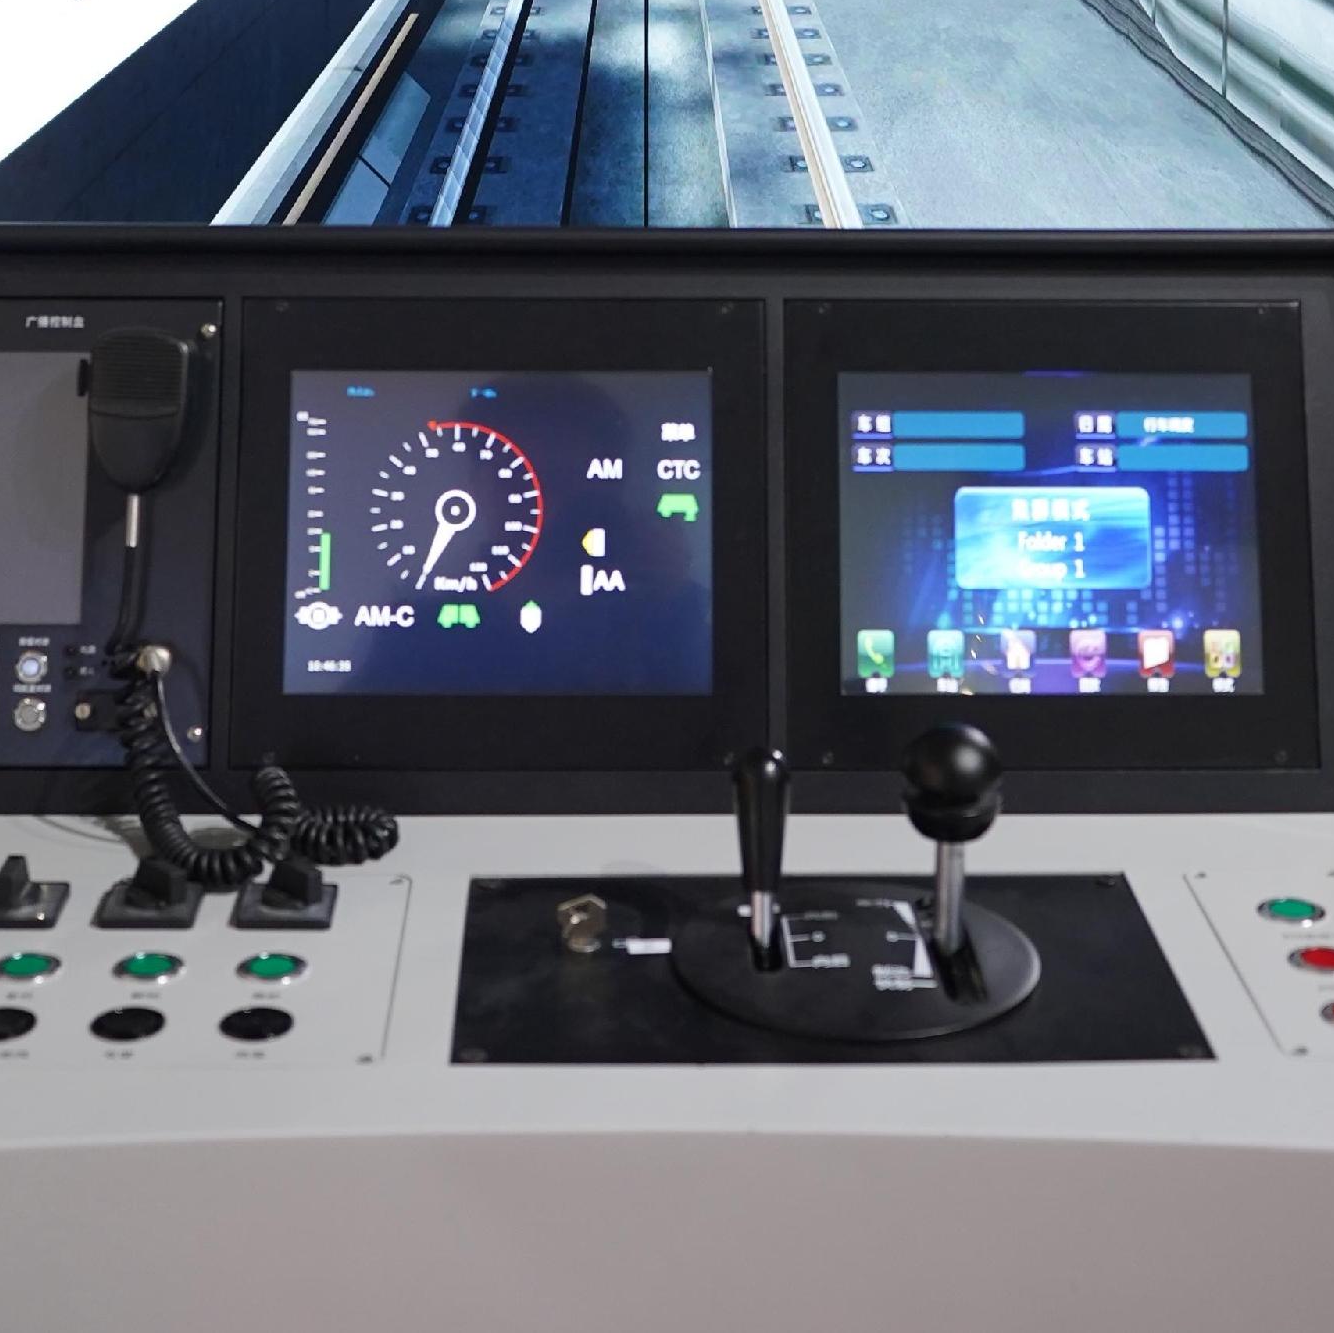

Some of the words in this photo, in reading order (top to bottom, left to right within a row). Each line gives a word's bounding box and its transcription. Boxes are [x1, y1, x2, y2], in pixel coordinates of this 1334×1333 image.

[586, 457, 624, 481] AM
[656, 458, 702, 481] CTC
[353, 604, 416, 629] AM-C
